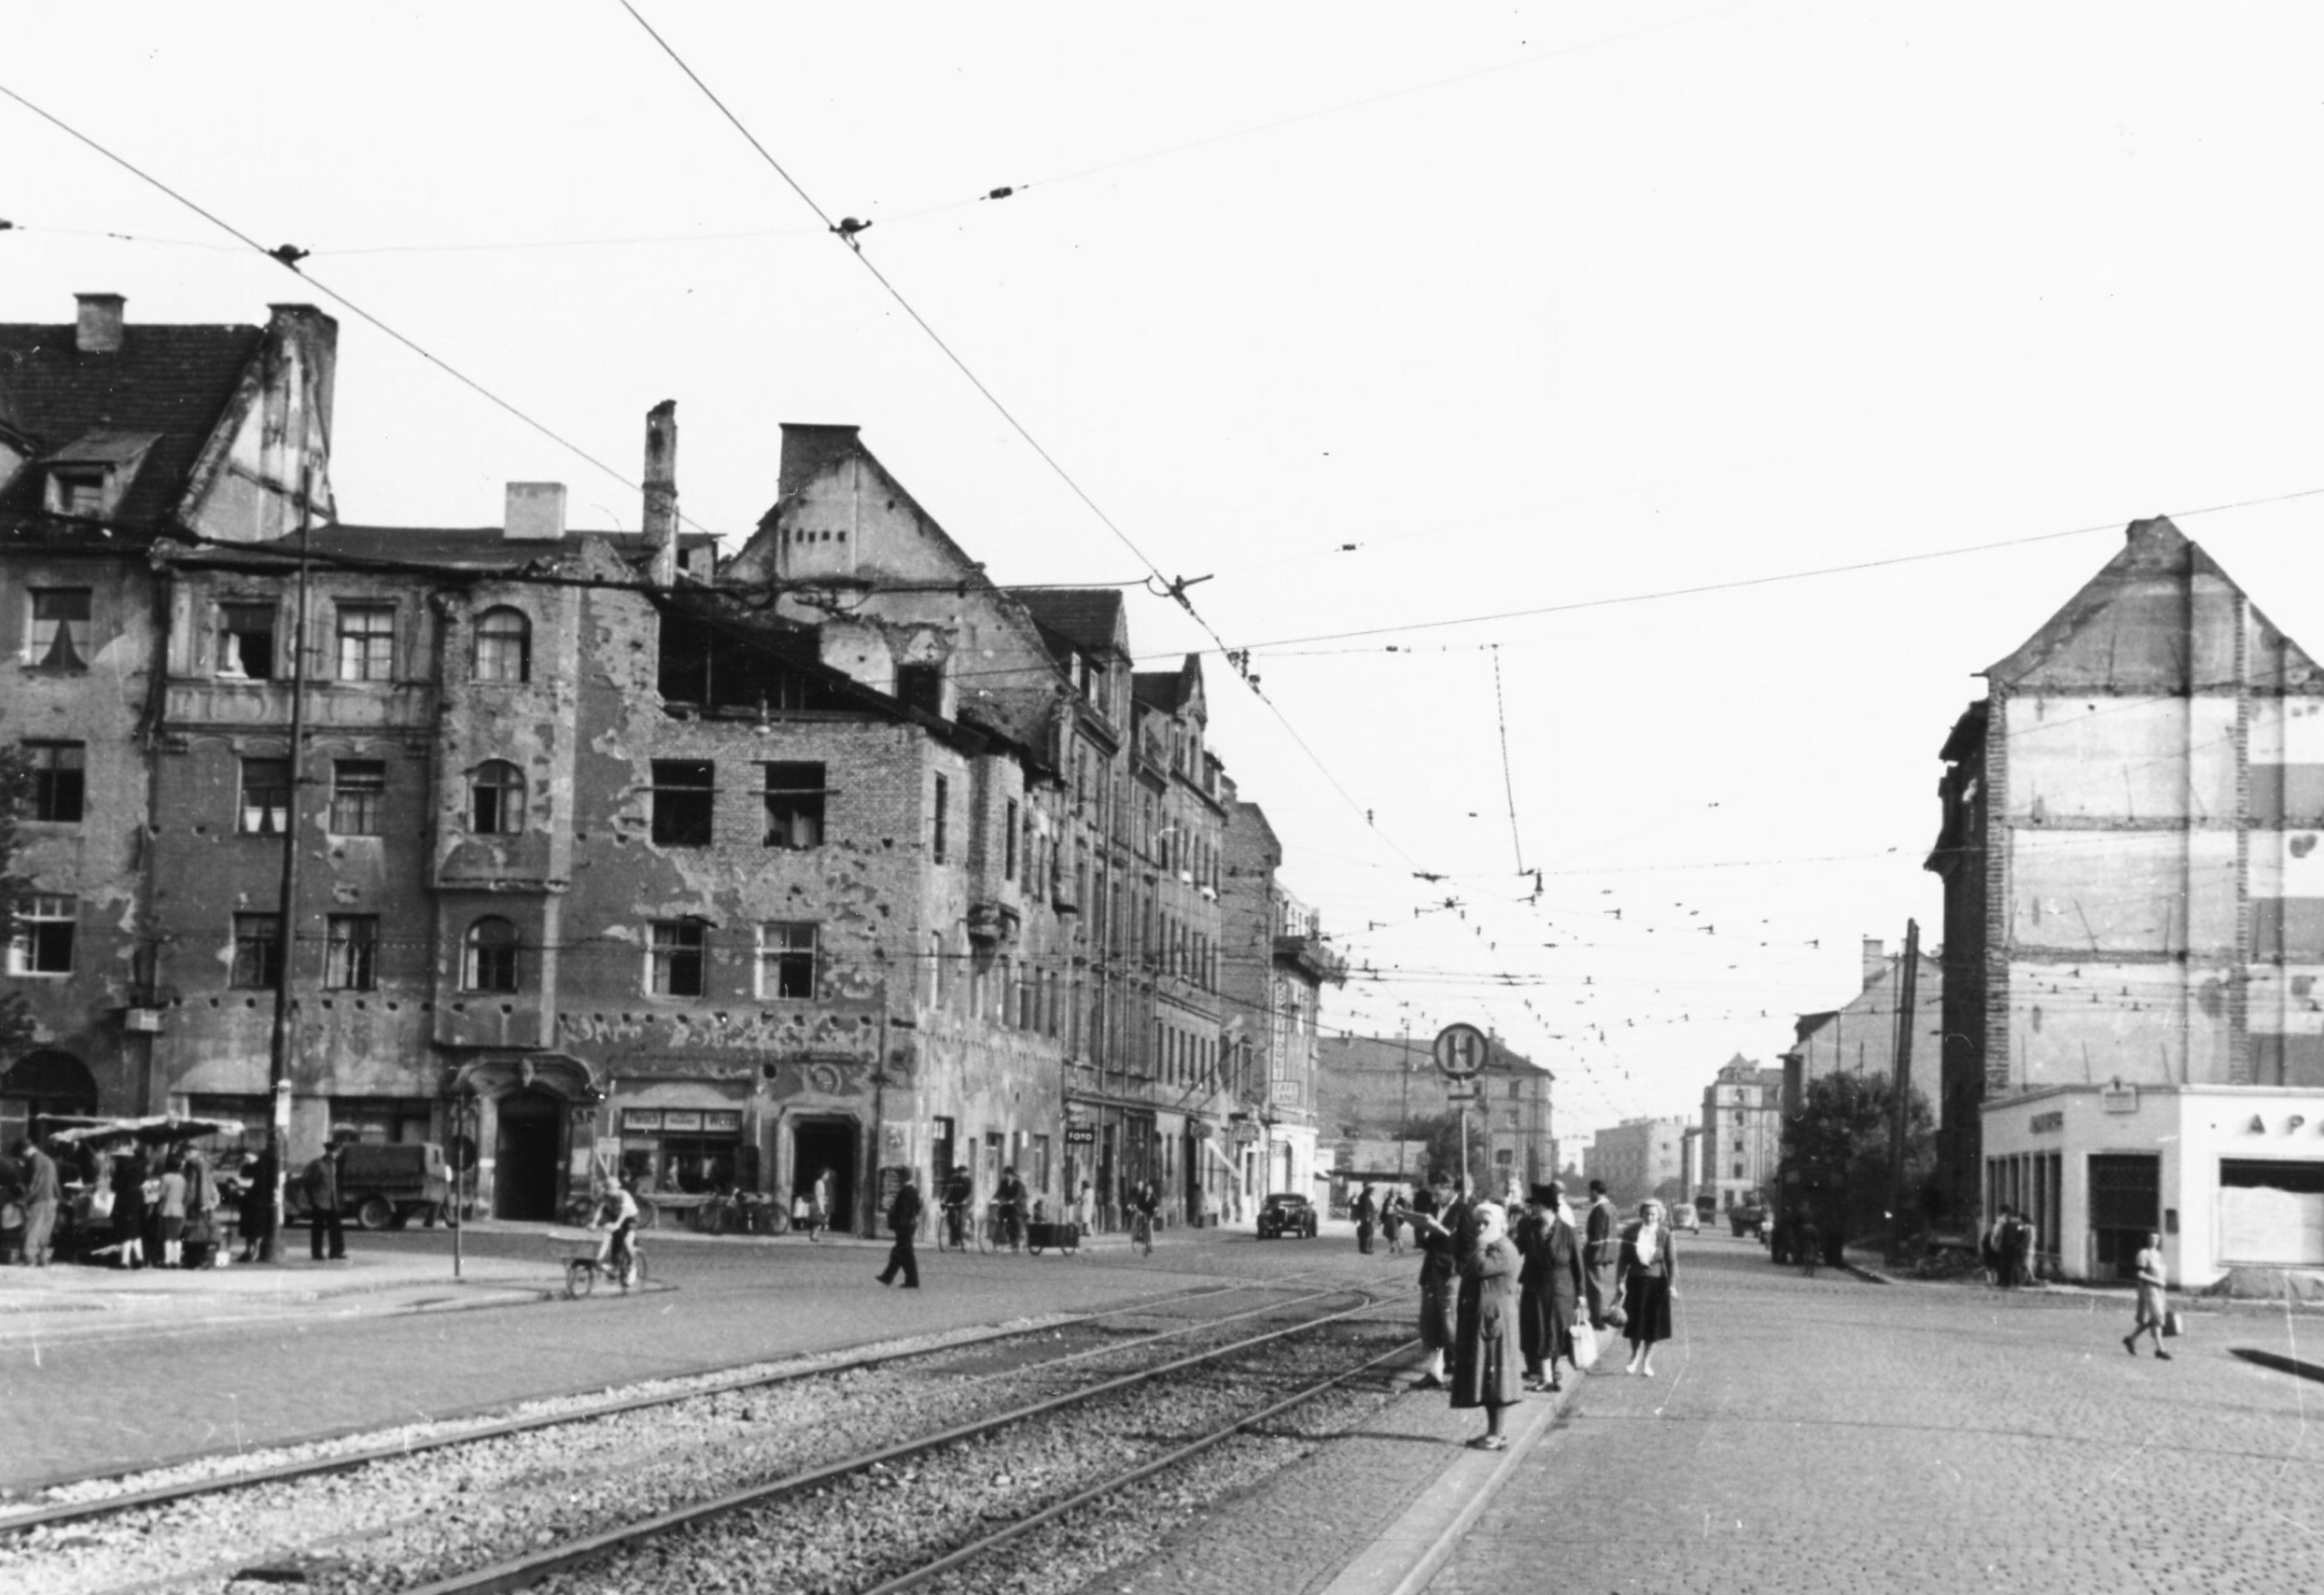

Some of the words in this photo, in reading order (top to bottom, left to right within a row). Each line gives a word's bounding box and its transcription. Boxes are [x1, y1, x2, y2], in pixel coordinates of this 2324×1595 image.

[1448, 1034, 1474, 1068] H
[1069, 1131, 1092, 1140] FOTO
[2246, 1114, 2324, 1137] AP
